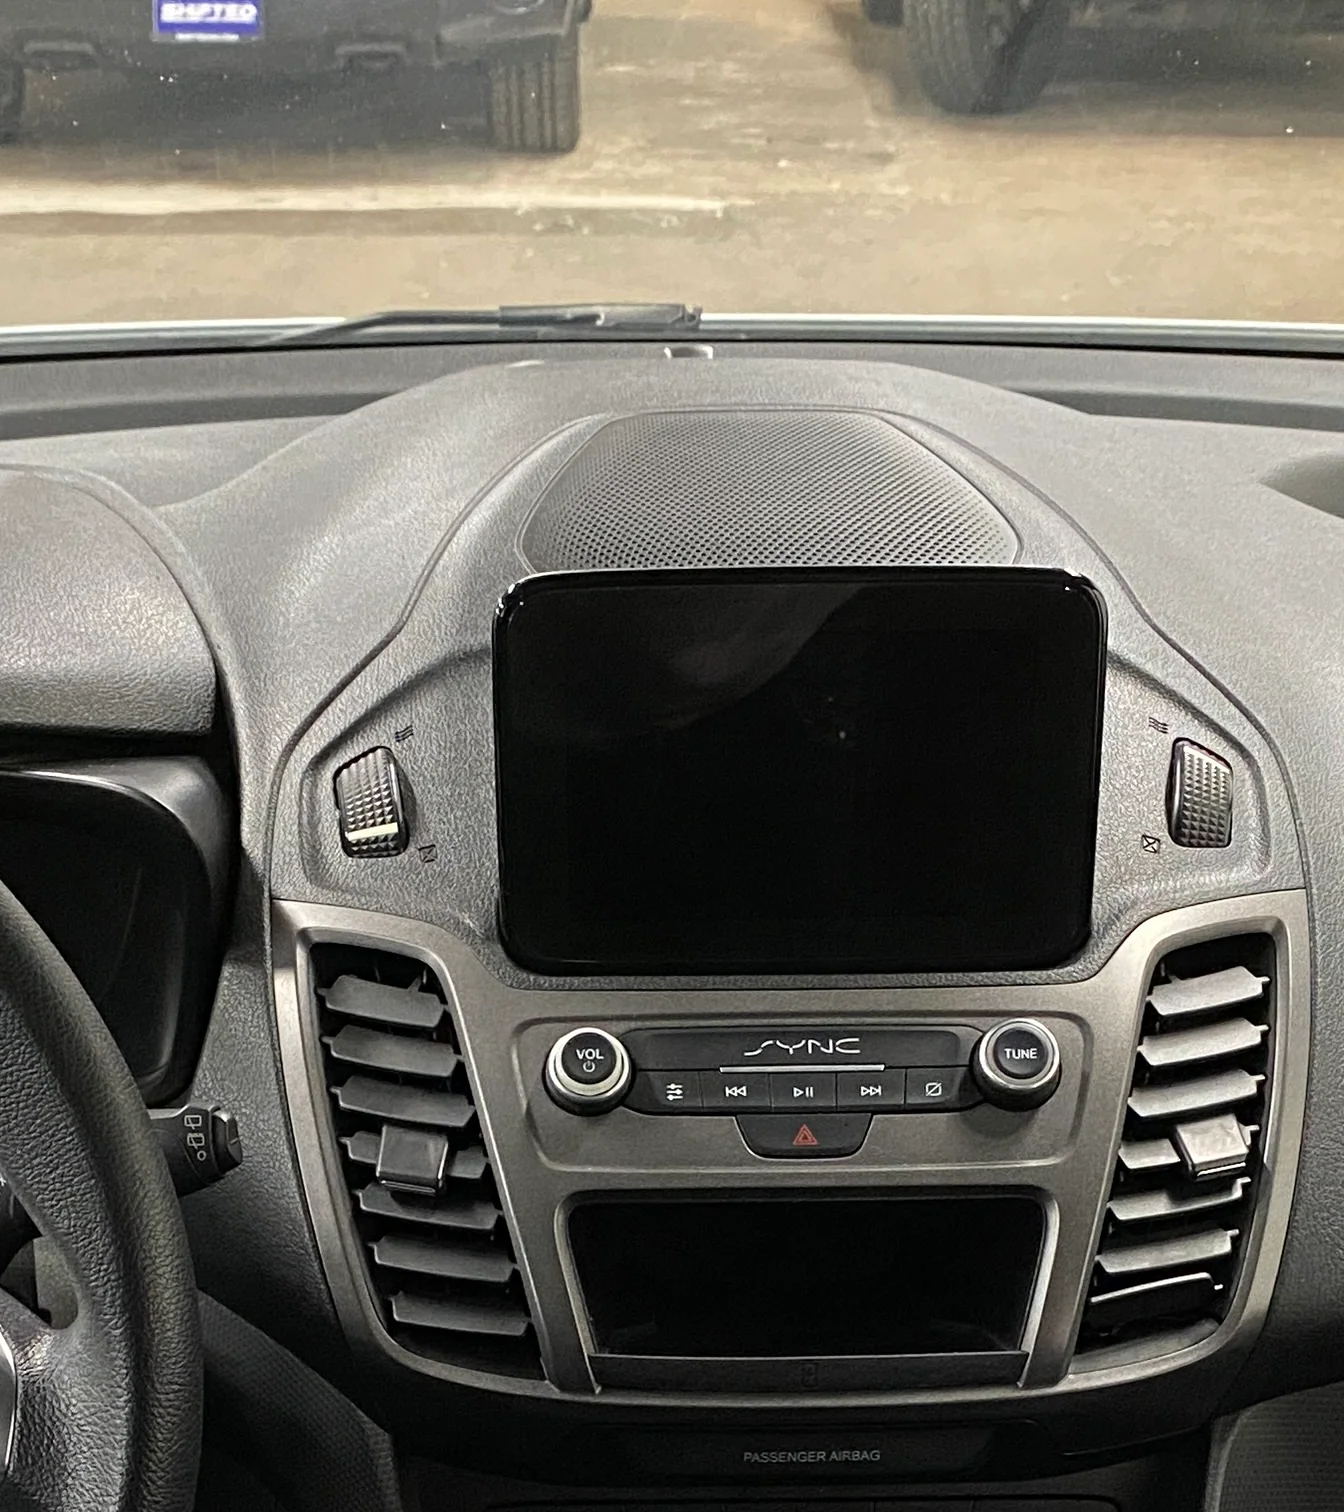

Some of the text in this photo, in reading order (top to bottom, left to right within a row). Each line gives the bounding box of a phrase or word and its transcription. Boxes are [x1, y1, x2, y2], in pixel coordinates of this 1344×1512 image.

[576, 1048, 604, 1060] VOL
[743, 1038, 861, 1057] SYNC
[1004, 1047, 1037, 1060] TUNE
[743, 1450, 881, 1463] PASSENGER AIRBAG
